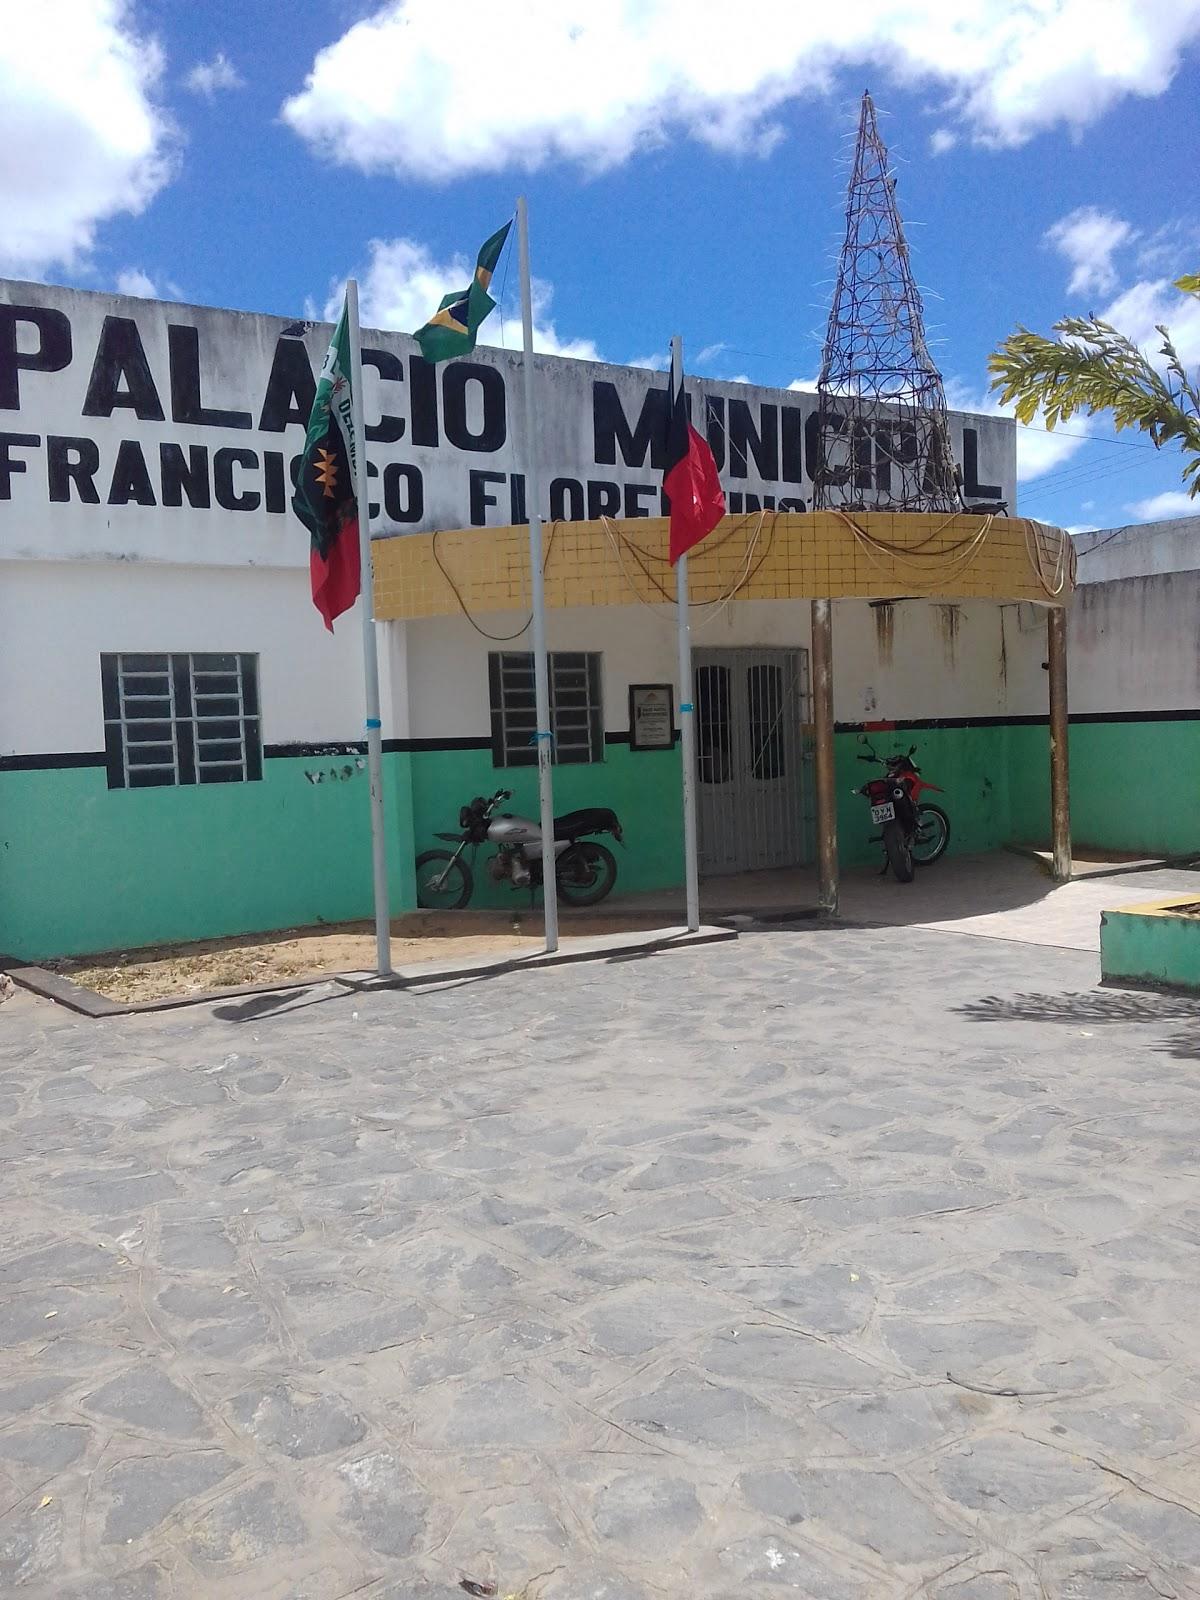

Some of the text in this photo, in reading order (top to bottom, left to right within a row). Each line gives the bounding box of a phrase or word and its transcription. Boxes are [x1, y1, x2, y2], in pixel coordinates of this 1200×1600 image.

[0, 304, 507, 453] PALÁCIO
[0, 432, 807, 526] FRANCIO FLOREIN
